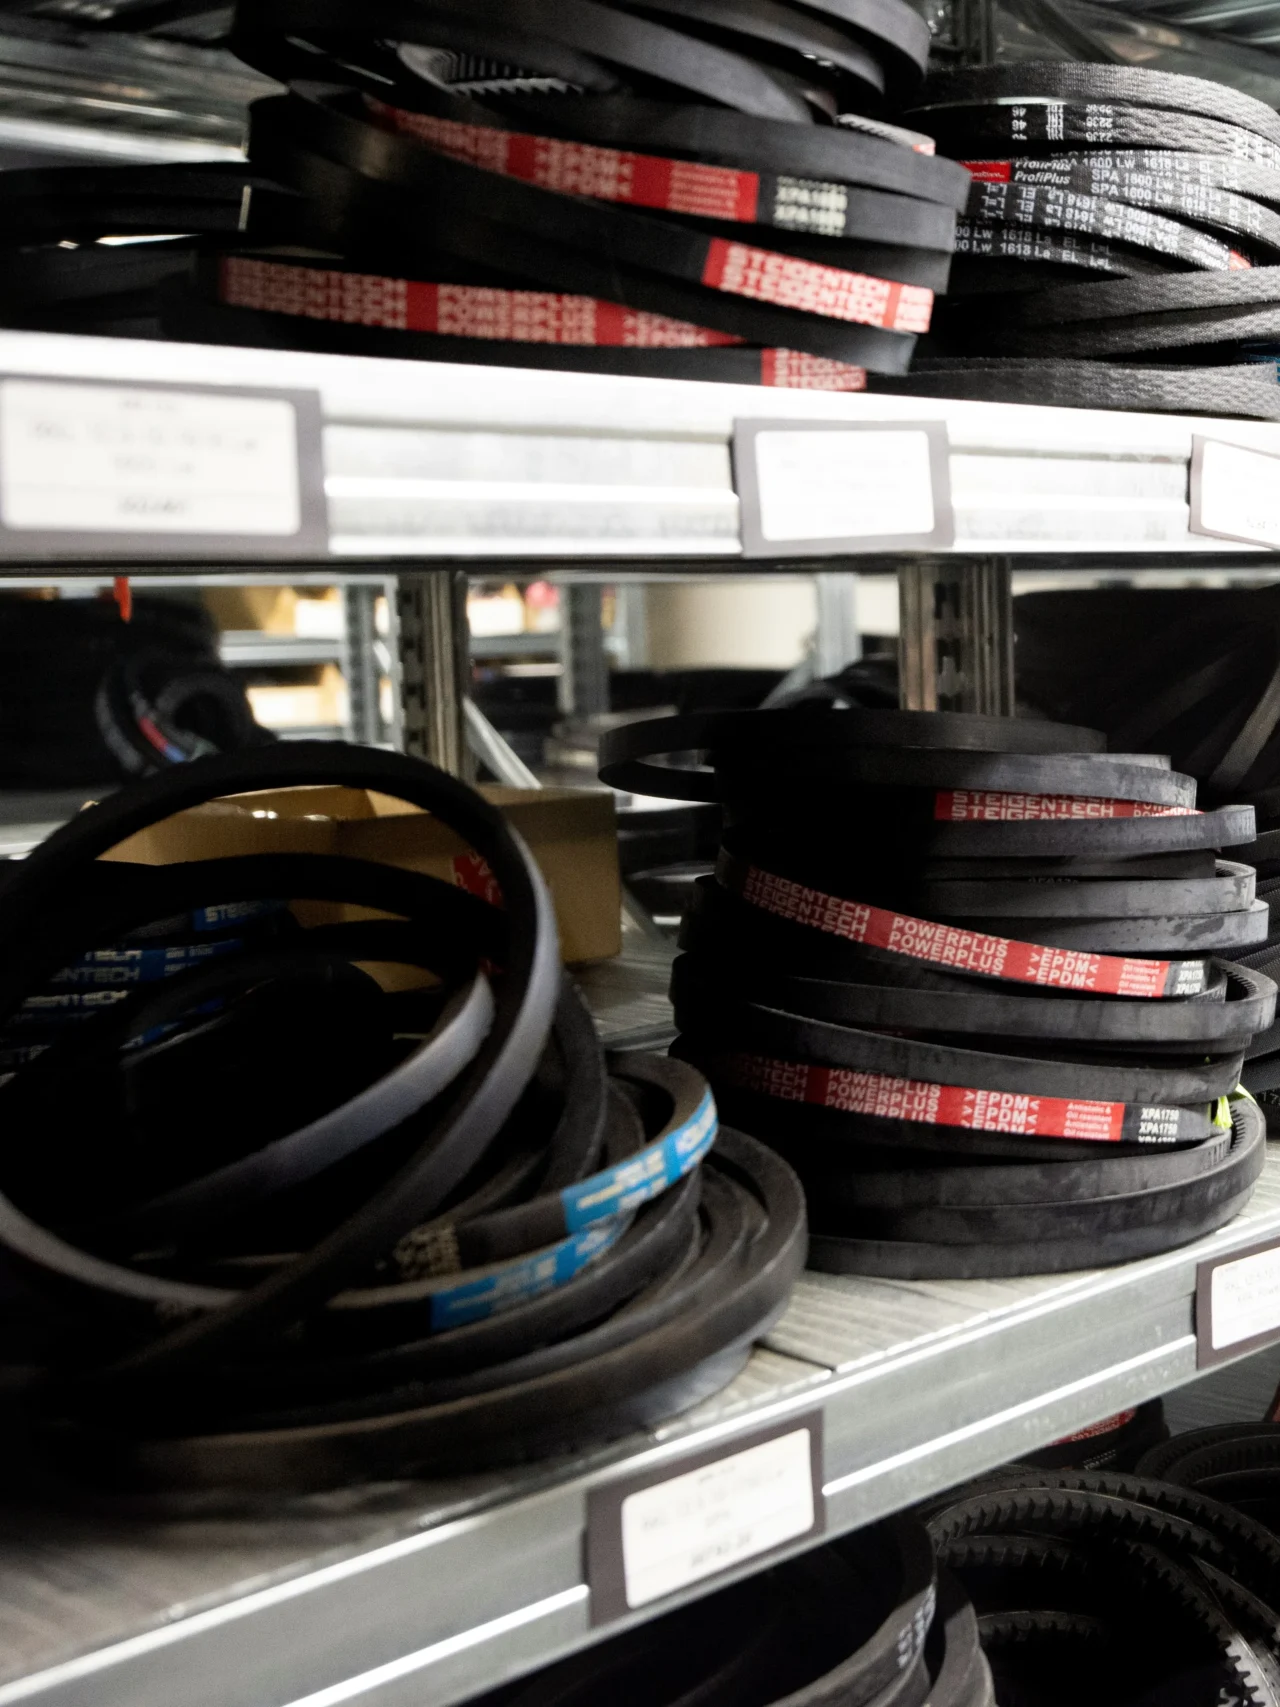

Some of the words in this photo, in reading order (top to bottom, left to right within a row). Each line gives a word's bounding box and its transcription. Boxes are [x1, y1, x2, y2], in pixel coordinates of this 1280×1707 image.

[1014, 171, 1071, 185] ProfiPlus
[1092, 169, 1119, 182] SPA
[1090, 183, 1119, 196] SPA
[1000, 243, 1032, 256] 1618
[1034, 246, 1051, 259] La
[1062, 250, 1079, 263] EL
[952, 790, 1114, 817] STEIGENTECH
[748, 866, 871, 921] STEIGENTECH
[744, 878, 867, 934] STEIGENTECH
[892, 916, 1009, 959] POWERPLUS
[888, 930, 1005, 973] POWERPLUS
[826, 1081, 940, 1112] POWERPLUS
[963, 1090, 1040, 1110] >EPDM<
[962, 1104, 1038, 1125] >EPDM<
